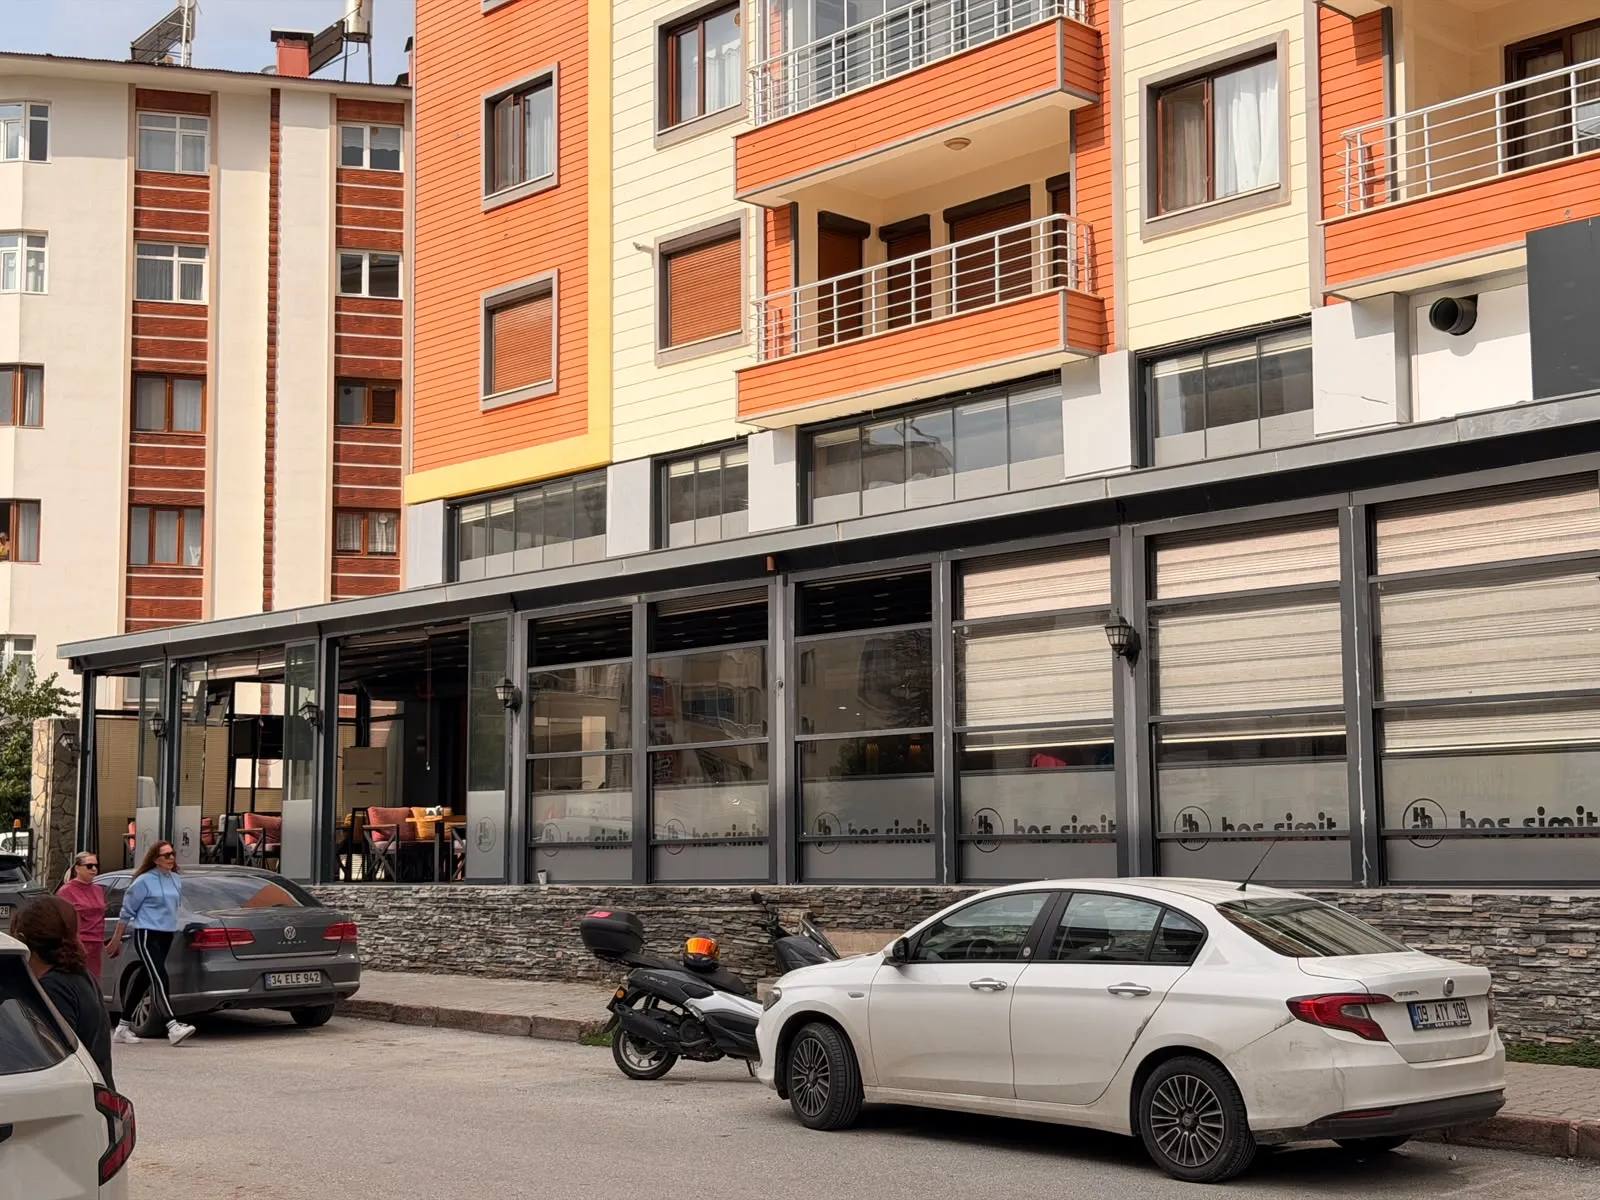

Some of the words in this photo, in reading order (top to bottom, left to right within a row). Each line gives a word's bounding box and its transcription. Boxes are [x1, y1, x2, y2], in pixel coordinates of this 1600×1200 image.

[885, 819, 931, 844] simit
[1060, 814, 1117, 844] simit
[1273, 811, 1337, 841] simit
[1522, 805, 1598, 838] simit
[271, 975, 282, 985] 34
[285, 973, 302, 984] ELE
[303, 972, 320, 983] 942
[1416, 1005, 1429, 1022] 09
[1434, 1003, 1450, 1021] ATY
[1452, 1001, 1468, 1020] 109
